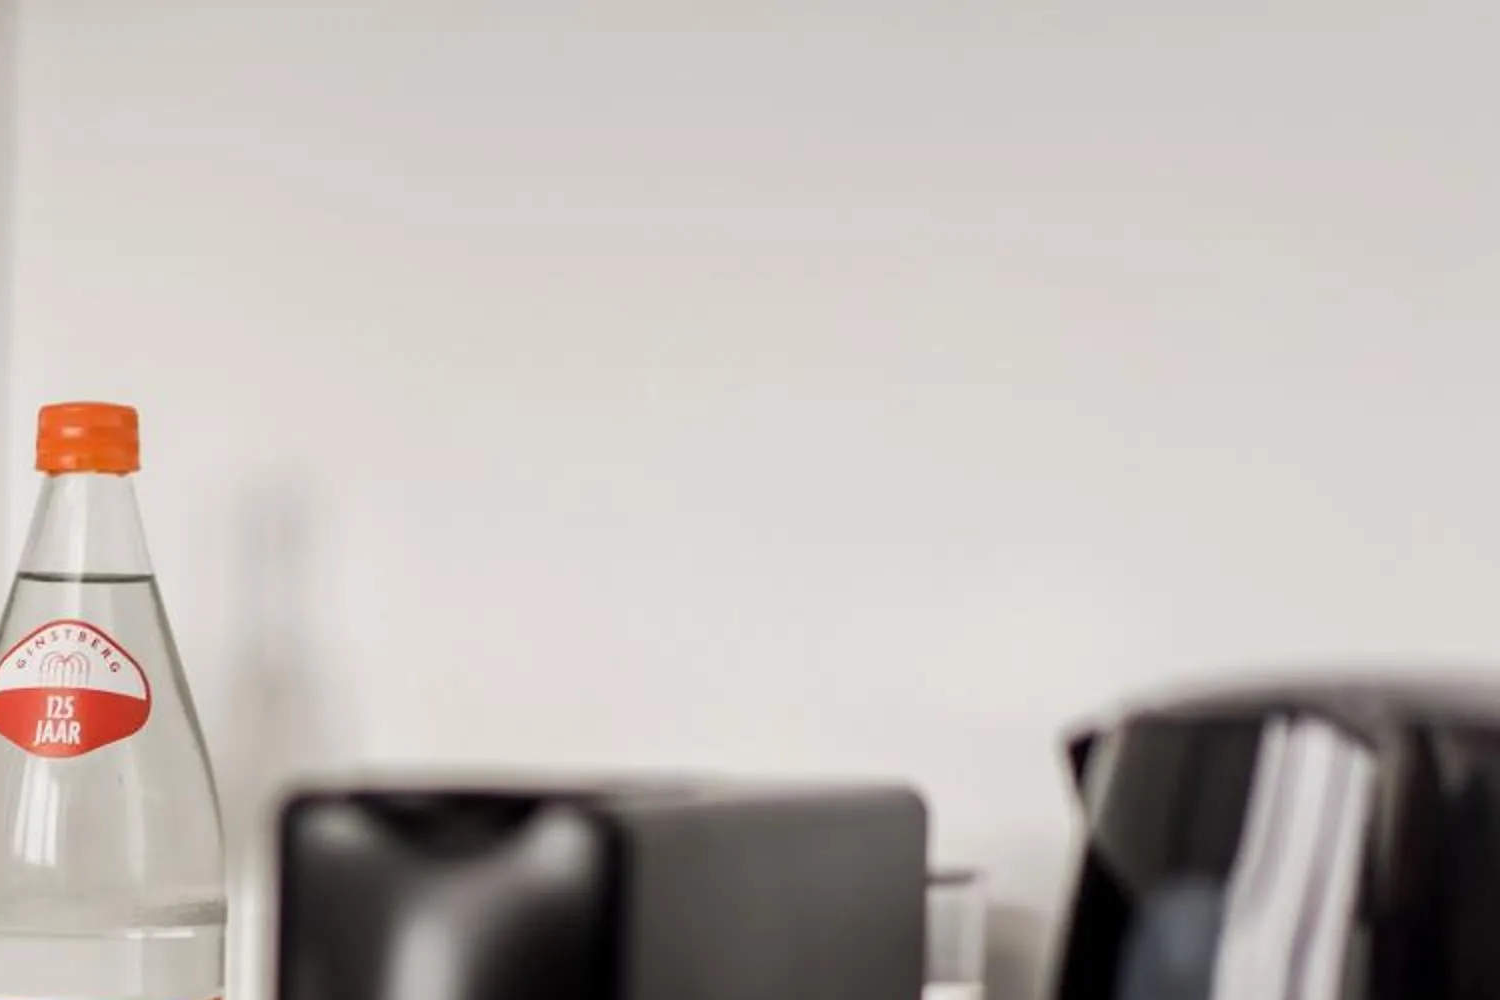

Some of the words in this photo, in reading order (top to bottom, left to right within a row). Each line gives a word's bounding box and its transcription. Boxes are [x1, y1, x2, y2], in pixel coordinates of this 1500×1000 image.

[15, 629, 121, 673] GINSTBERG
[46, 695, 75, 719] 125
[34, 719, 81, 747] JAAR
